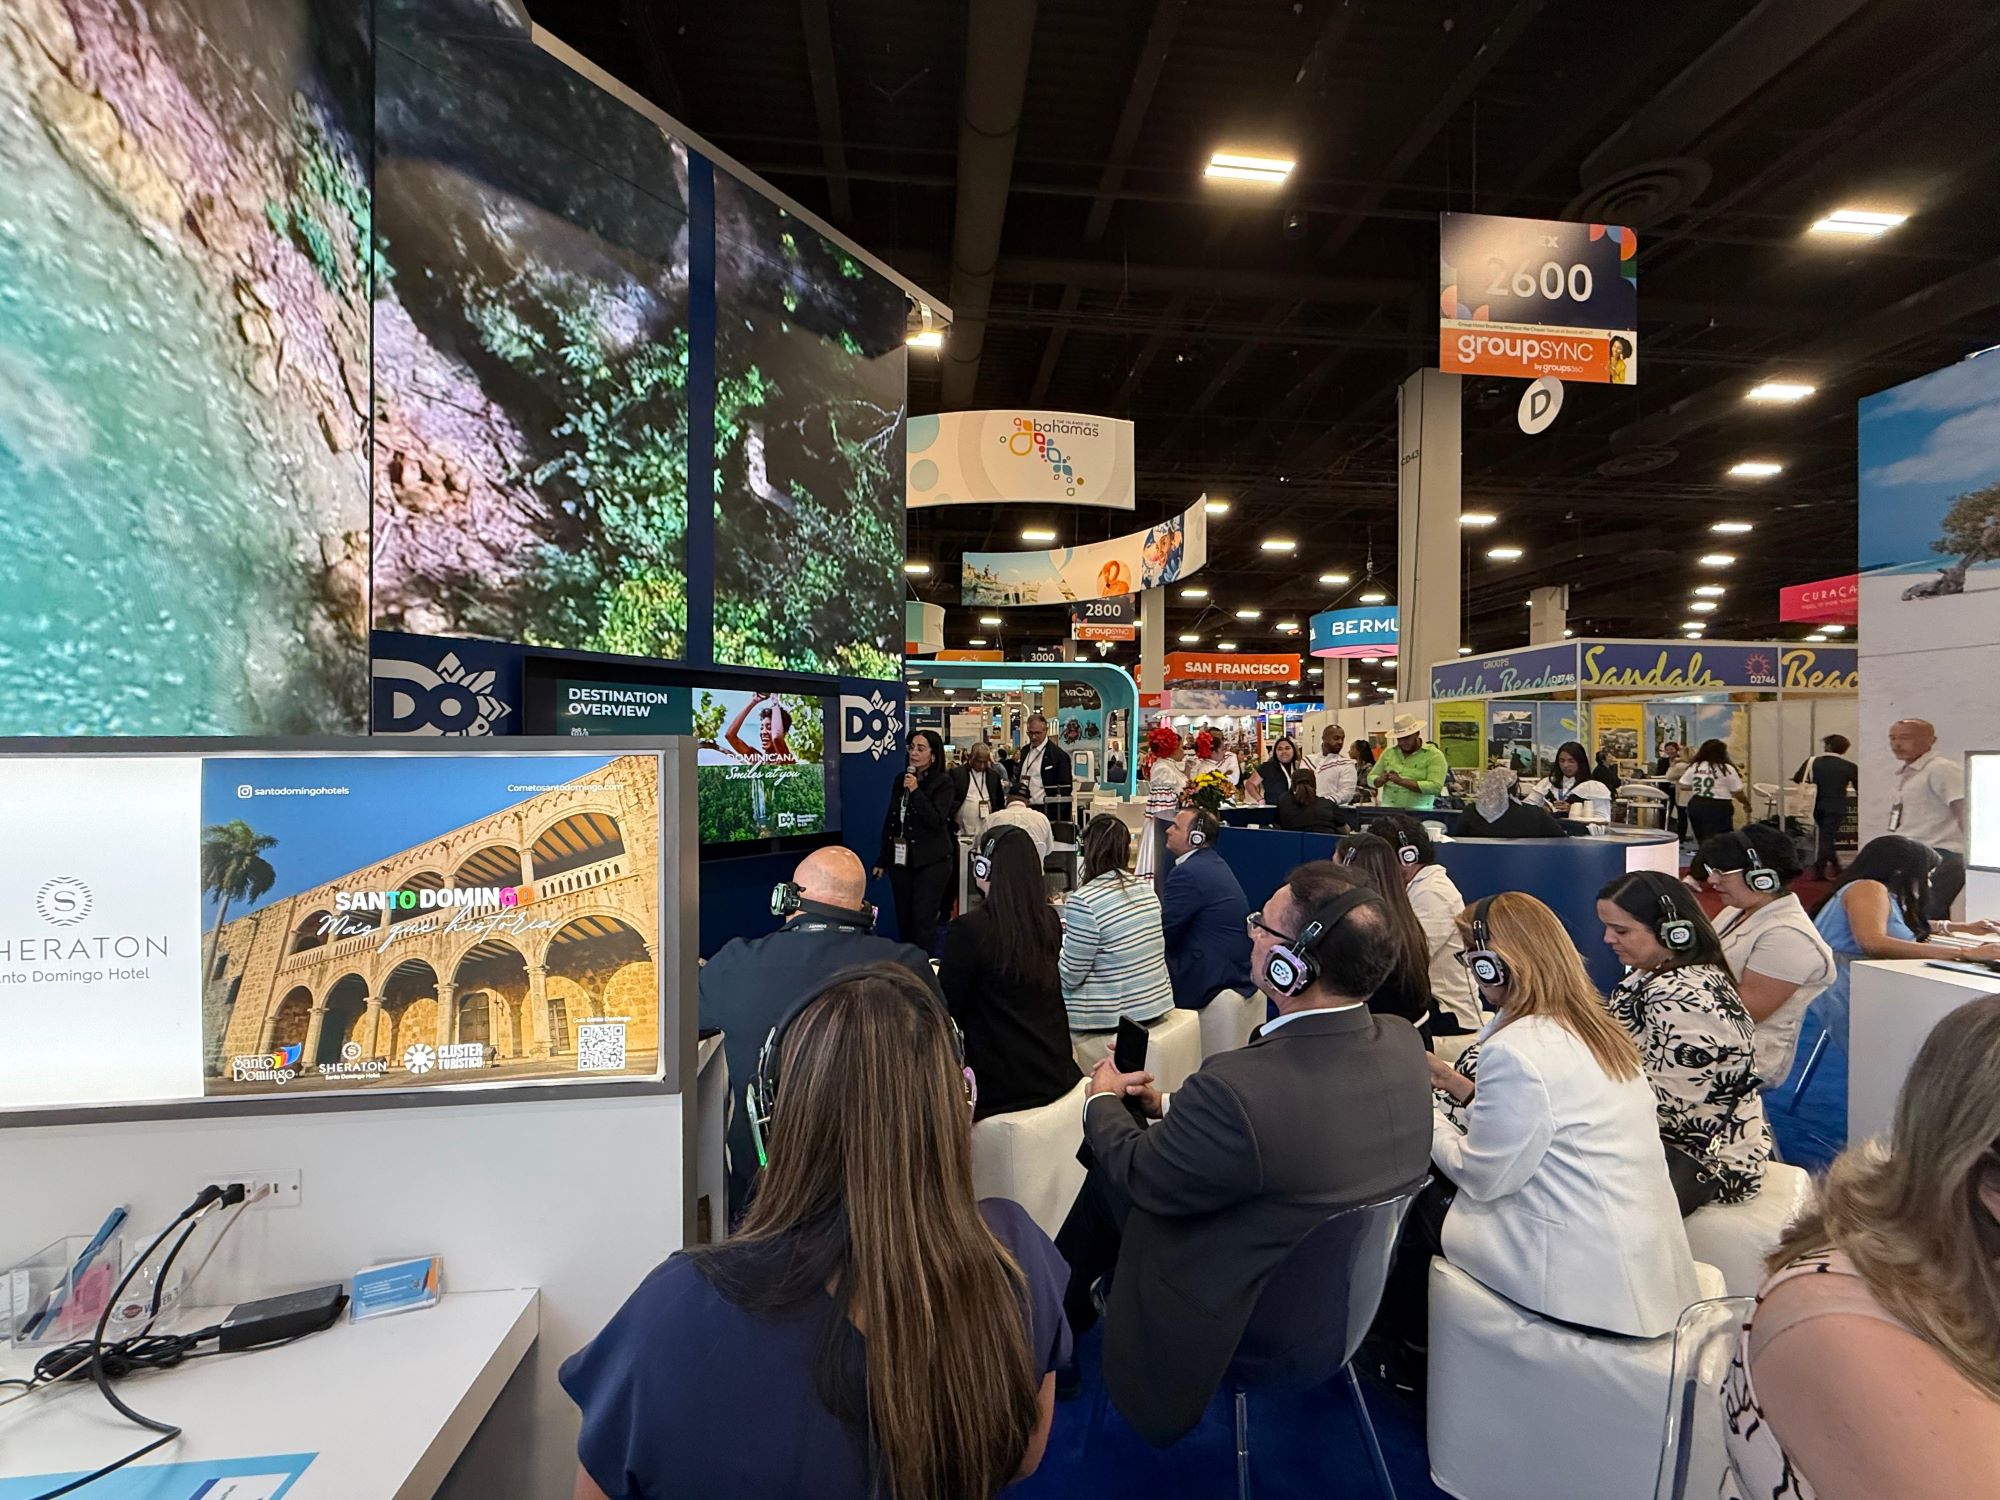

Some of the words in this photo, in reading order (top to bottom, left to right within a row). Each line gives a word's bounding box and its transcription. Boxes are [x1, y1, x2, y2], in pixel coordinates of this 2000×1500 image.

[1485, 257, 1593, 302] 2600
[1457, 334, 1594, 365] groupSYNC
[1530, 388, 1551, 422] D
[1033, 419, 1099, 437] bahamas
[1085, 603, 1122, 617] 2800
[1030, 653, 1055, 662] 3000
[1581, 645, 1725, 686] Sandals
[1185, 661, 1212, 673] SAN
[1215, 663, 1290, 675] FRANCISCO
[1432, 674, 1493, 699] Sandals
[1500, 665, 1572, 692] Beach
[1551, 674, 1575, 684] D2746
[1750, 675, 1776, 684] D2746
[568, 687, 668, 704] DESTINATION
[1064, 686, 1096, 698] vaCay
[568, 702, 651, 717] OVERVIEW
[725, 760, 763, 780] Smiles
[765, 766, 780, 778] at
[773, 770, 800, 787] you
[1693, 776, 1714, 788] 20
[254, 786, 350, 796] santodomingohotels
[507, 783, 625, 792] Cometosantodomingo.com
[335, 889, 417, 912] SANTO
[419, 885, 534, 909] DOMINGO
[316, 913, 382, 937] Más
[377, 921, 438, 954] que
[443, 903, 559, 945] historia
[32, 969, 104, 984] Domingo
[108, 967, 150, 980] Hotel
[232, 1053, 275, 1070] Santo
[318, 1061, 387, 1073] SHERATON
[233, 1066, 296, 1085] Domingo
